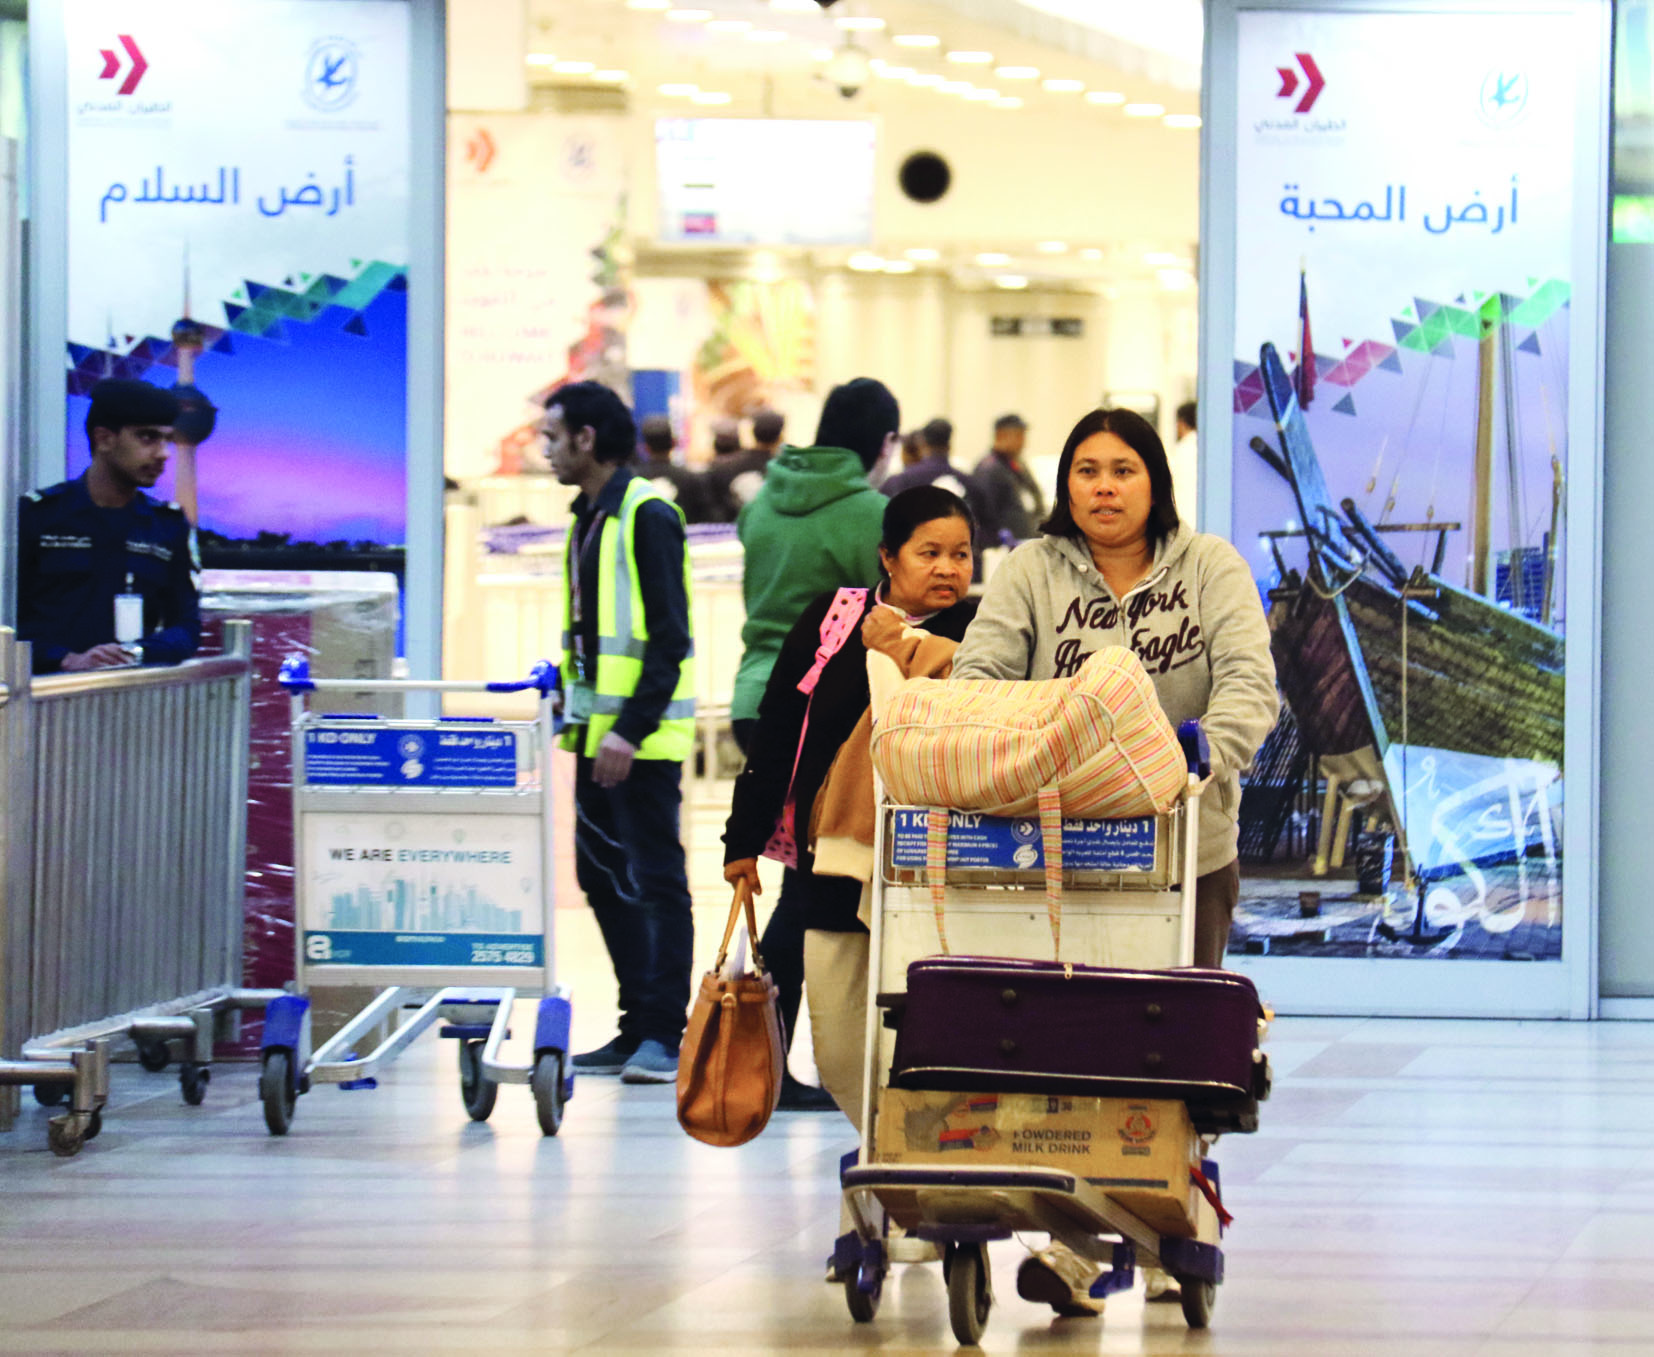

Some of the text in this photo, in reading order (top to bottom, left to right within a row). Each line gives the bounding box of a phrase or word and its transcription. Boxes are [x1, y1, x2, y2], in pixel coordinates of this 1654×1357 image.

[100, 154, 356, 223] أرض السلام
[1279, 174, 1519, 234] أرض المحبة
[1055, 579, 1189, 634] New York
[1130, 616, 1205, 674] Eagle
[900, 813, 907, 827] 1
[948, 814, 983, 829] NLY
[328, 848, 512, 864] WE ARE EVERYWHERE
[1012, 1142, 1091, 1155] MILK DRINK
